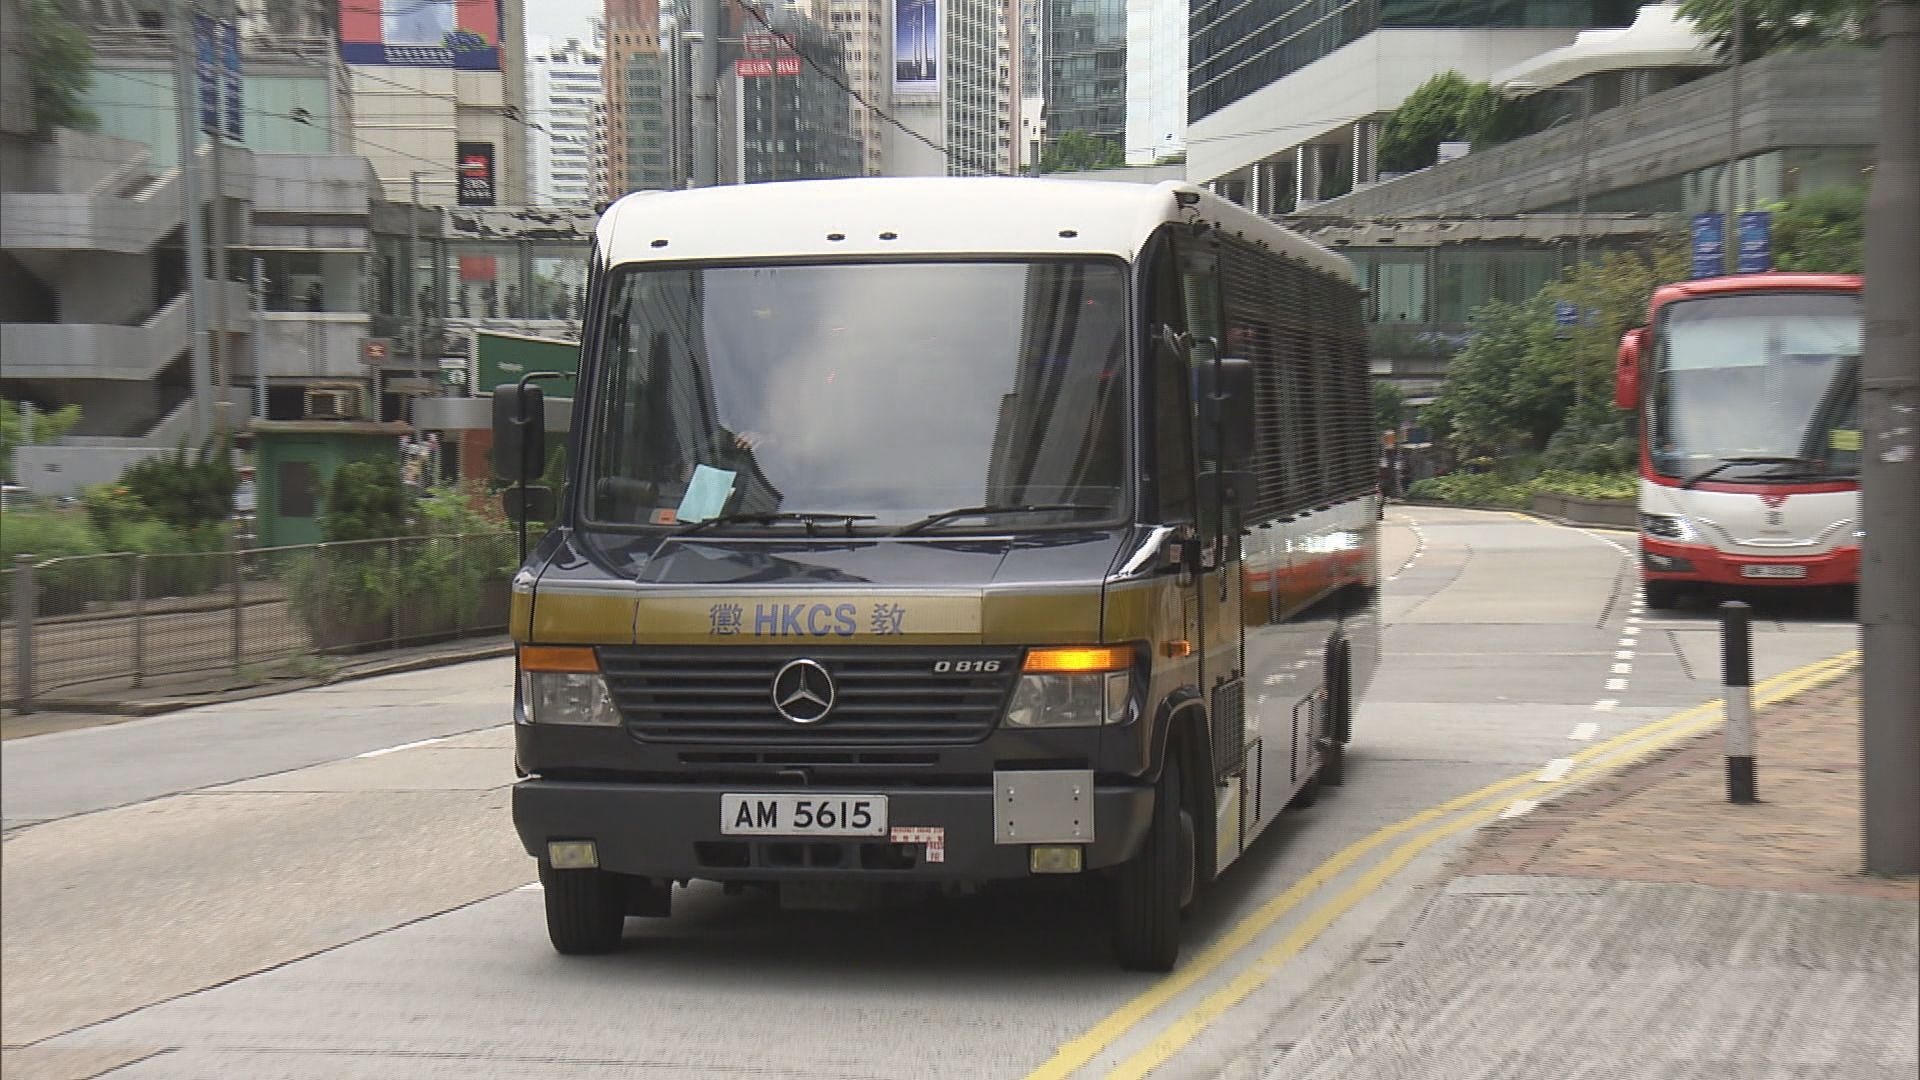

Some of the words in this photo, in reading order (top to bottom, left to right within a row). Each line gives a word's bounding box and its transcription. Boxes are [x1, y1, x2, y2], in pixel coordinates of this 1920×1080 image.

[463, 177, 490, 189] DBS
[709, 603, 743, 635] 懲
[755, 603, 857, 636] HKCS
[955, 660, 1001, 672] 816
[734, 801, 778, 828] AM
[793, 801, 872, 829] 5615
